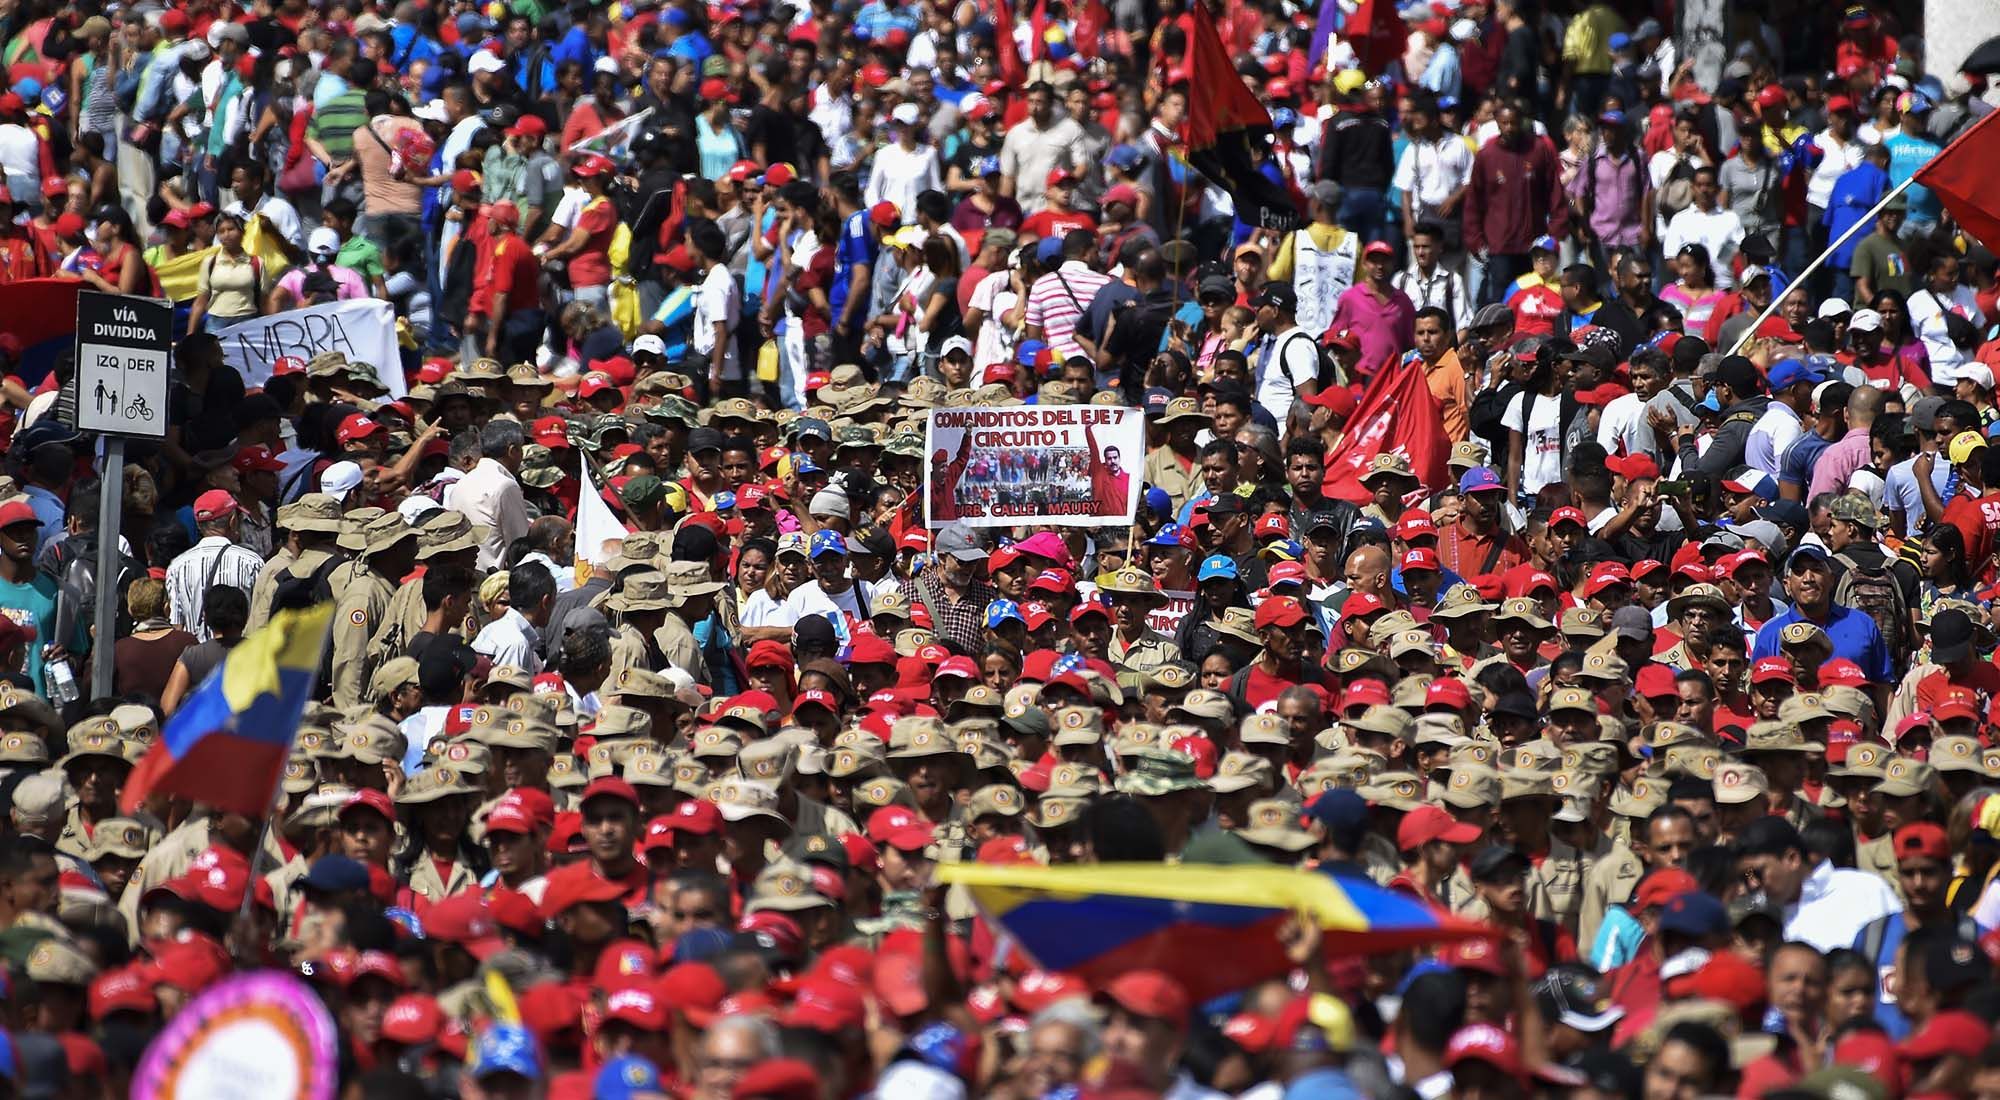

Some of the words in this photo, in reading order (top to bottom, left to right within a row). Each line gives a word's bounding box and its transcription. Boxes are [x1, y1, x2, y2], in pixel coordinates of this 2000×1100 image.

[113, 306, 138, 323] VÍA
[94, 323, 157, 341] DIVIDIDA
[96, 354, 119, 369] IZQ
[128, 358, 155, 372] DER
[935, 411, 1039, 428] COMANDITOS
[1042, 410, 1077, 426] DEL
[1081, 409, 1110, 425] EJE
[1113, 410, 1124, 425] 7
[974, 430, 1056, 447] CIRCUITO
[1060, 430, 1069, 445] 1
[955, 503, 986, 517] URB.
[991, 502, 1035, 516] CALLE
[1047, 500, 1101, 515] MAURY
